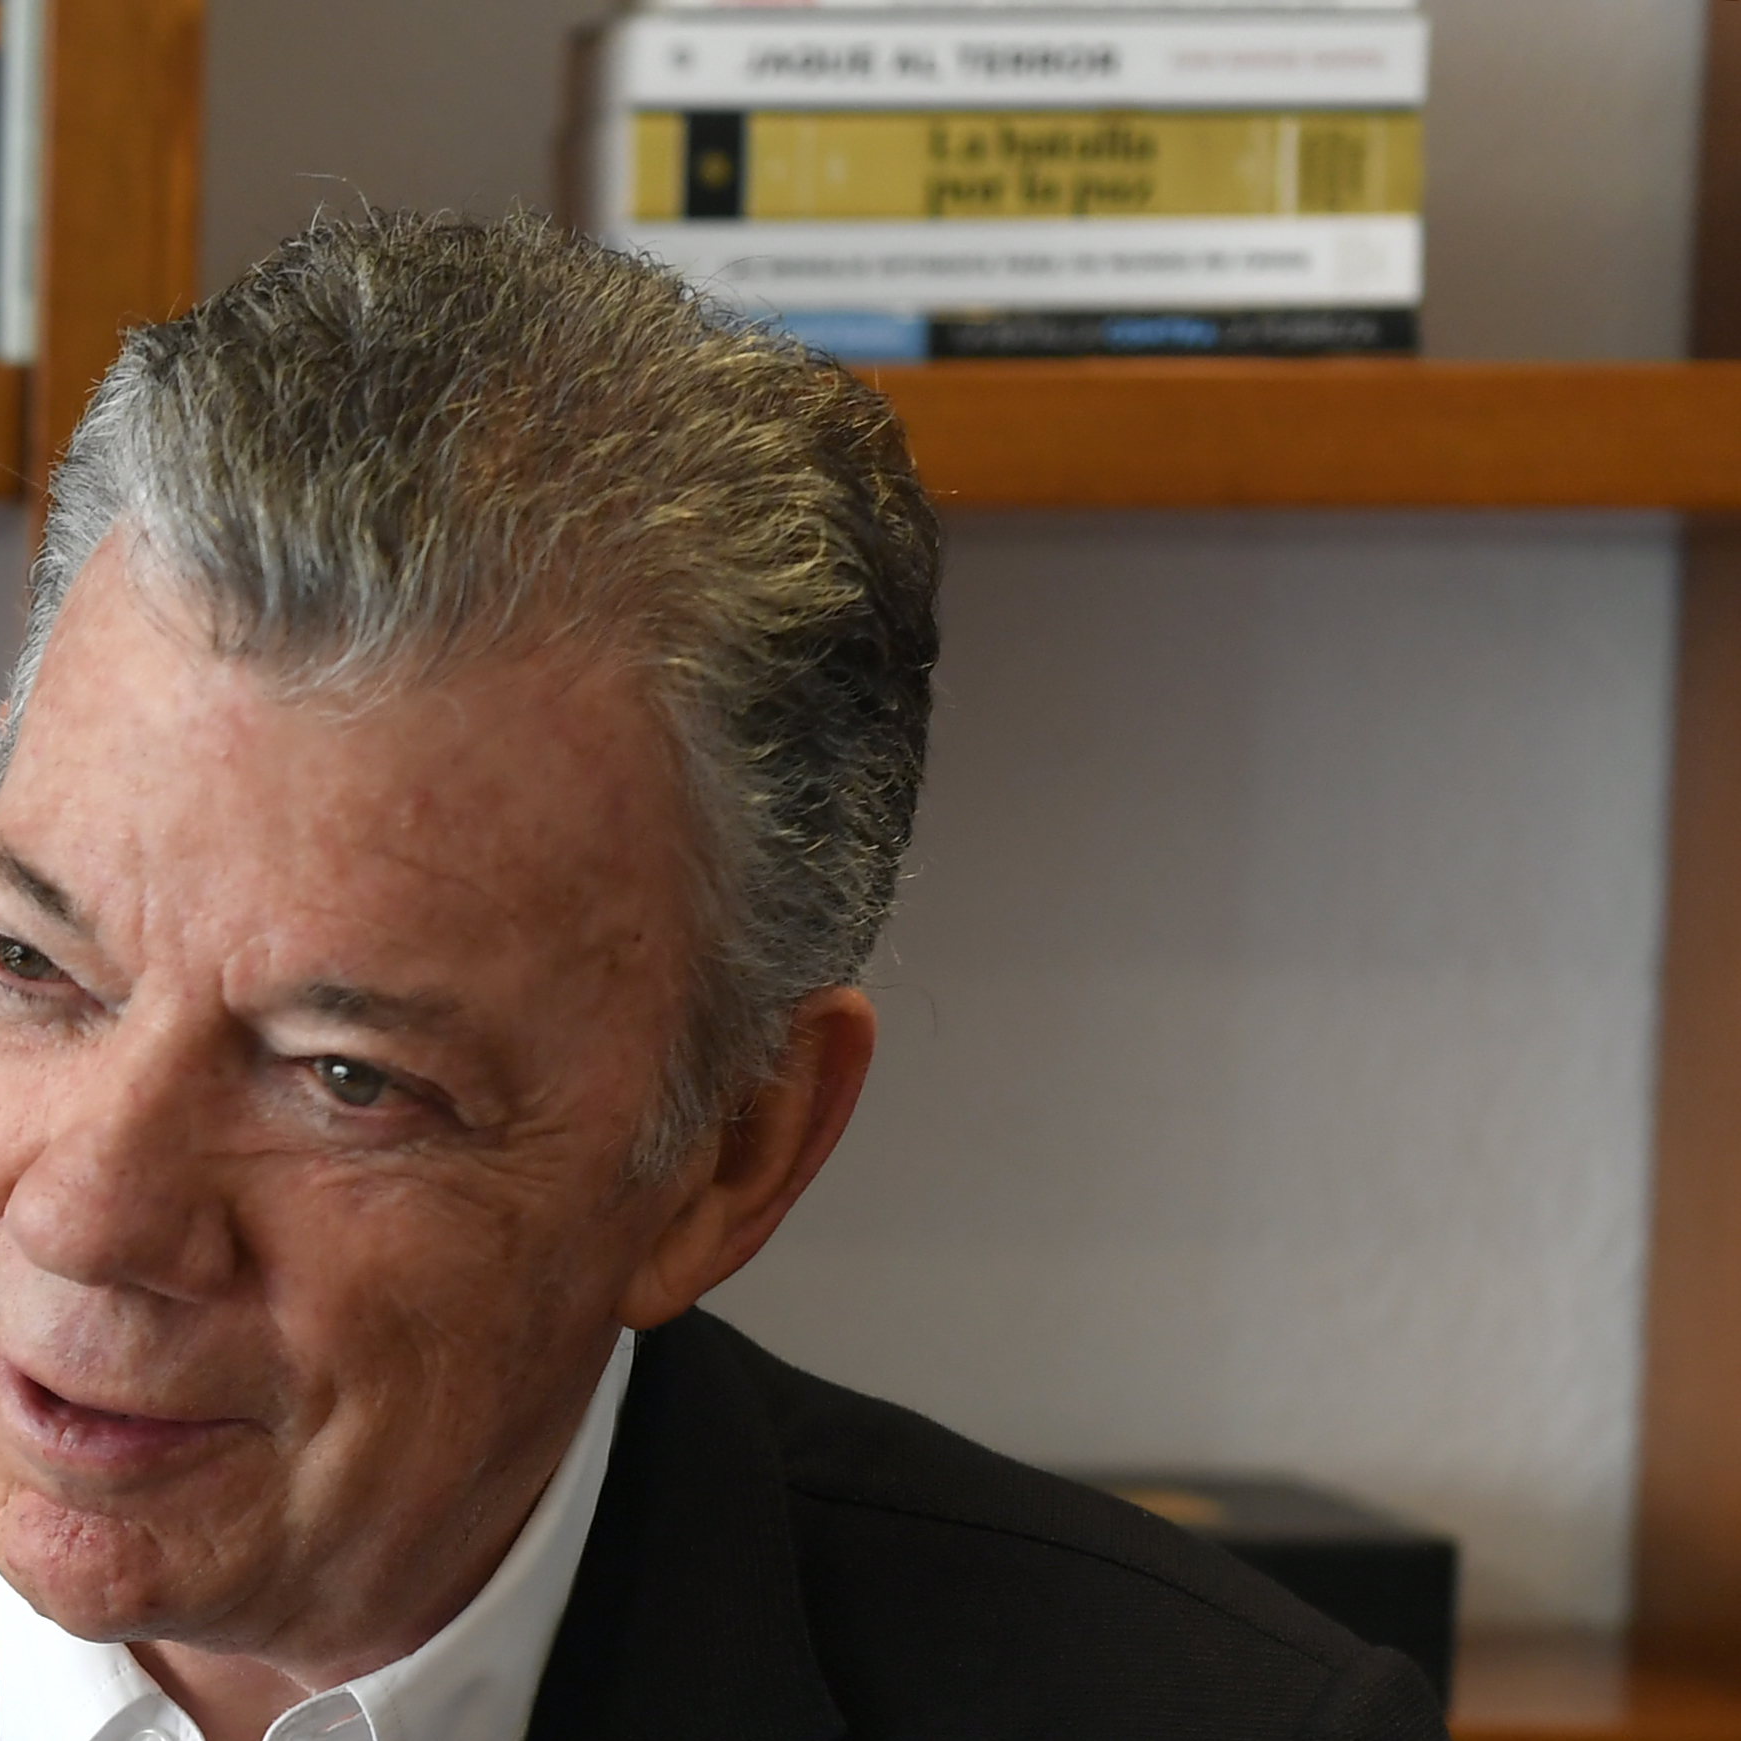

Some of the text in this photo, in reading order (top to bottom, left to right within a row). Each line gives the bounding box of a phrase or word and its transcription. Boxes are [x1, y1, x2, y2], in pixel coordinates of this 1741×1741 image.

[748, 42, 1121, 80] JAQUE AL TERROR
[929, 122, 1157, 160] La batalla
[926, 174, 1005, 216] por
